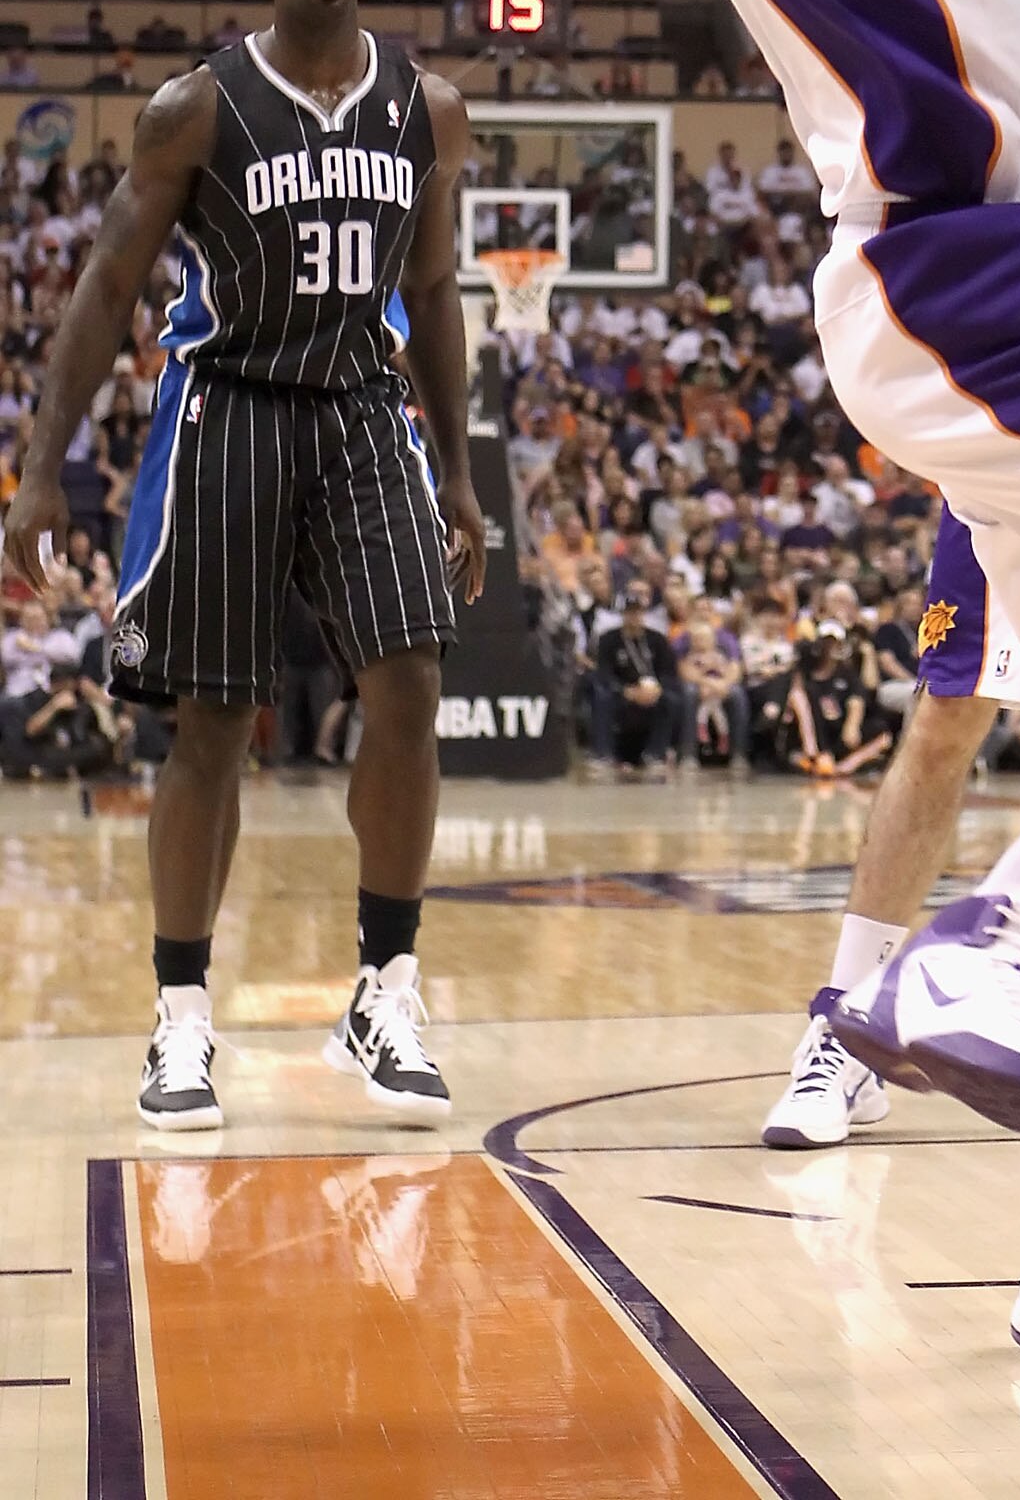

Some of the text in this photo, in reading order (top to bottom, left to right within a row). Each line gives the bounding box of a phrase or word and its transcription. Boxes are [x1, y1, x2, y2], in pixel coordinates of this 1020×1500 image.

[245, 147, 414, 216] ORLANDO
[295, 220, 374, 295] 30
[498, 695, 549, 739] TV
